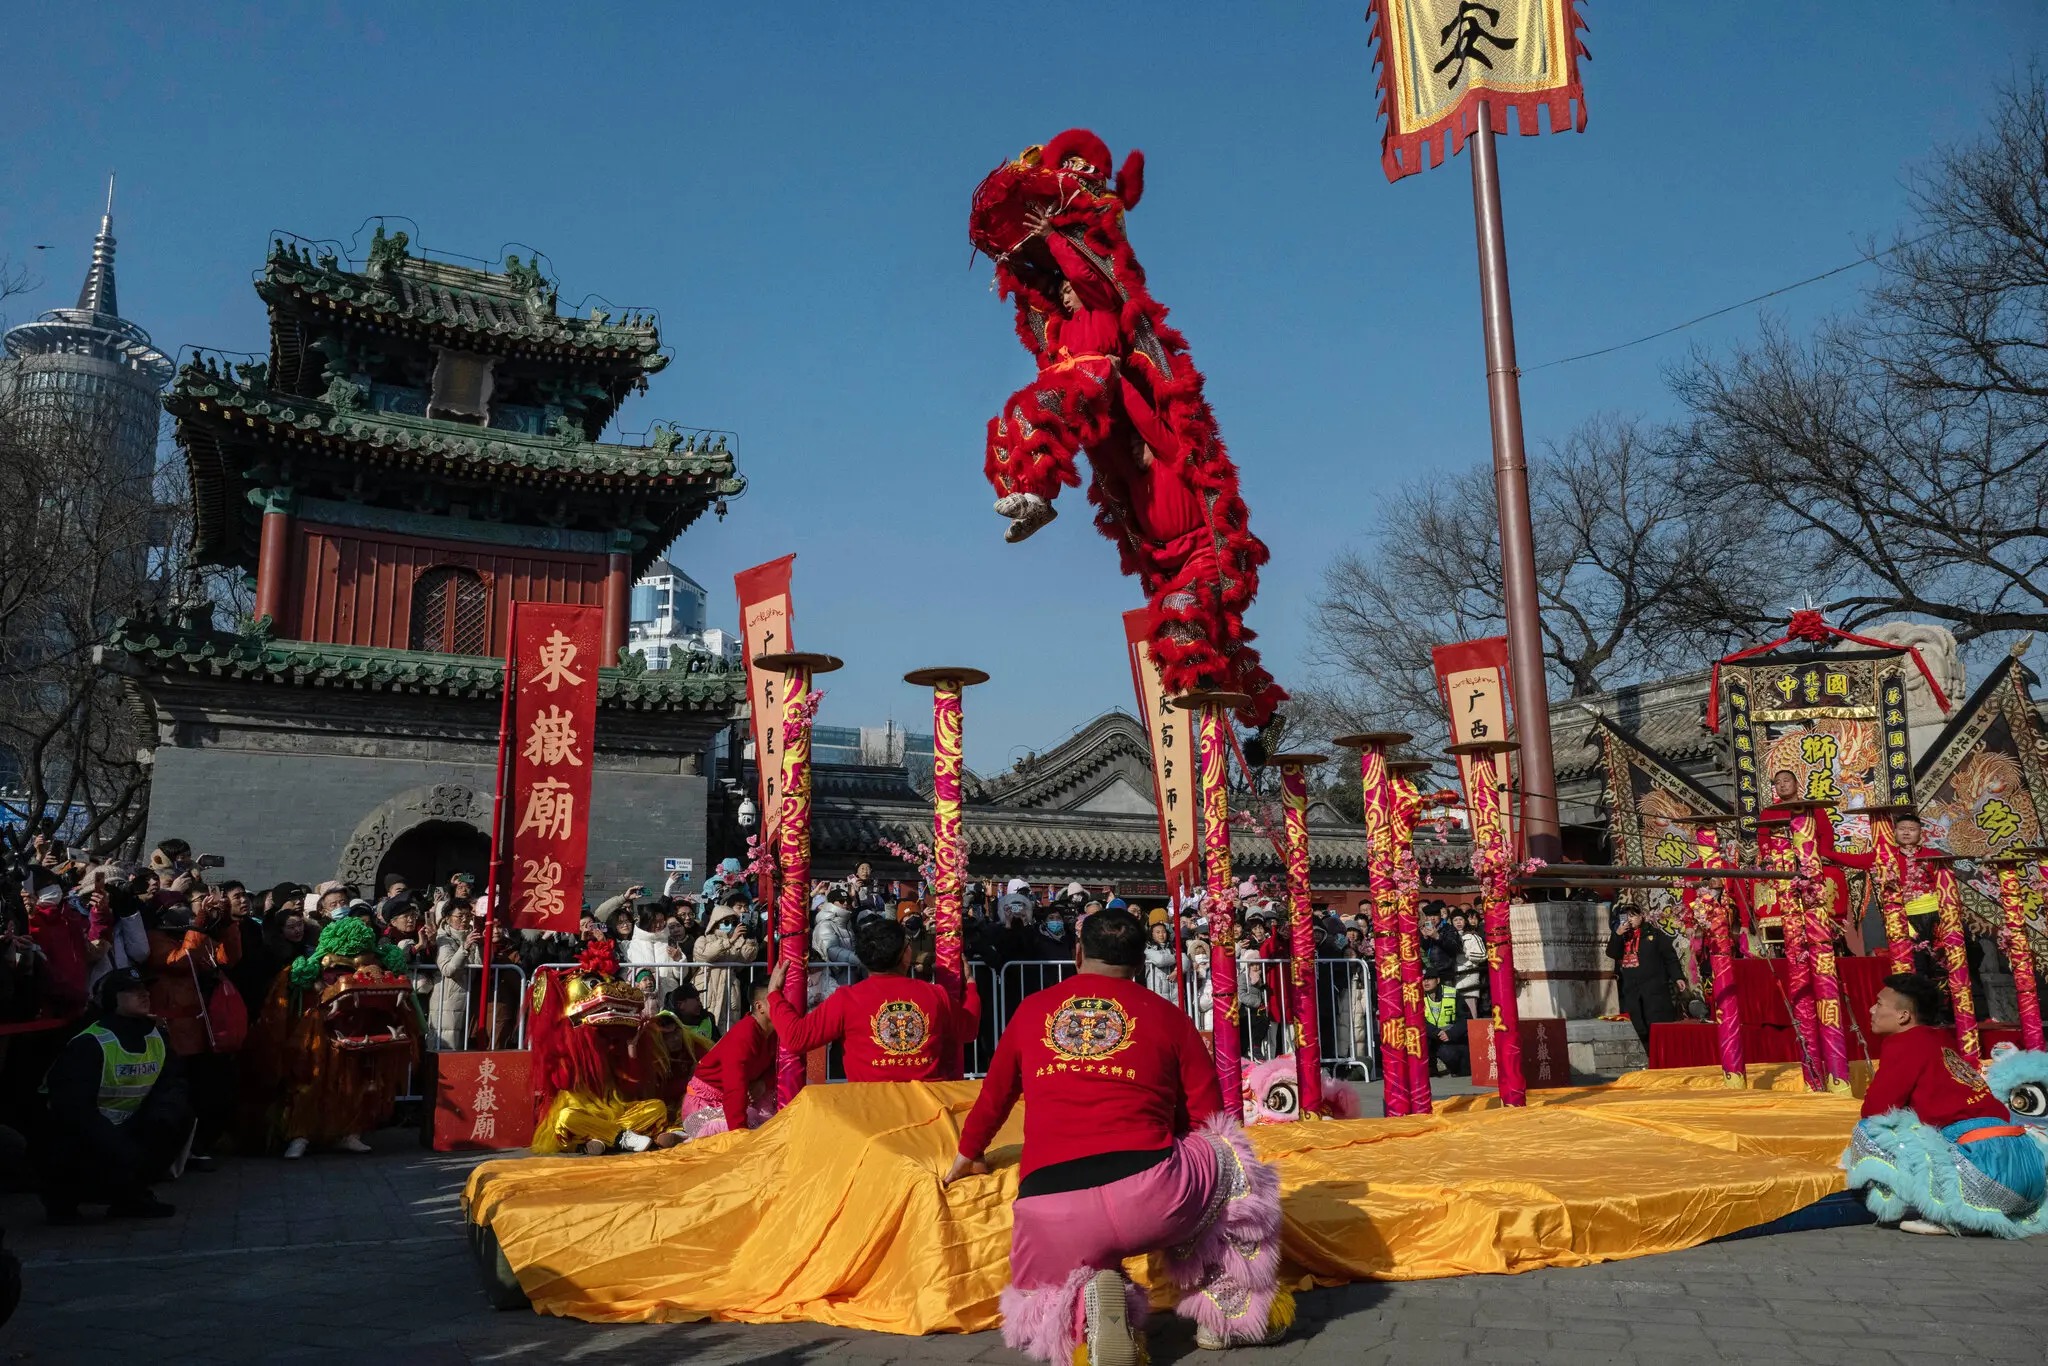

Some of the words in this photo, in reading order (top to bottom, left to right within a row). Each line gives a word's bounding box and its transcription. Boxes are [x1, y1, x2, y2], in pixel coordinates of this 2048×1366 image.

[1433, 0, 1519, 90] 安
[1468, 690, 1488, 739] 广西
[1804, 672, 1819, 701] 北京
[515, 630, 587, 841] 東嶽廟
[1080, 1000, 1103, 1009] 北京
[470, 1058, 500, 1141] 東嶽廟
